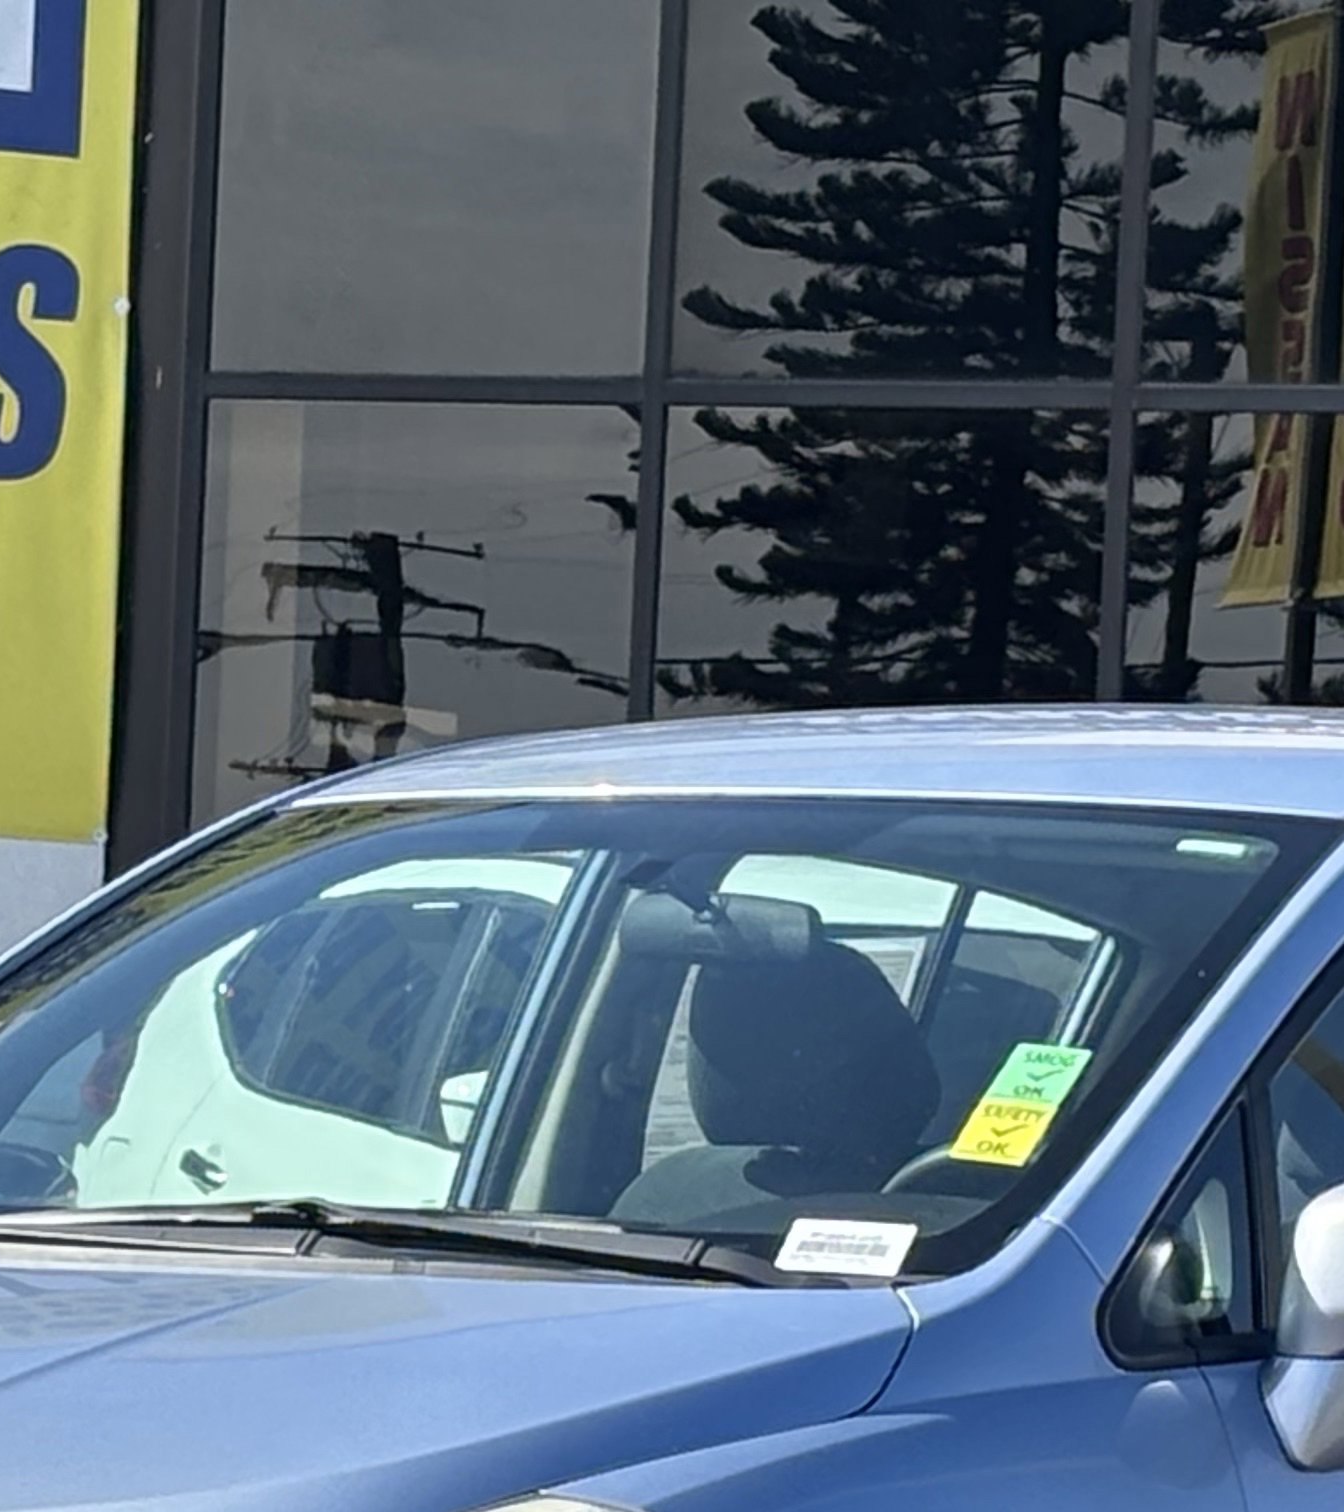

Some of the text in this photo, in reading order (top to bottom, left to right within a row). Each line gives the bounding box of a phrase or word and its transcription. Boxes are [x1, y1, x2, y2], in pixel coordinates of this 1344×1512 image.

[1024, 1050, 1077, 1067] SMOG
[981, 1103, 1047, 1123] SAFETY
[976, 1139, 1010, 1155] OK
